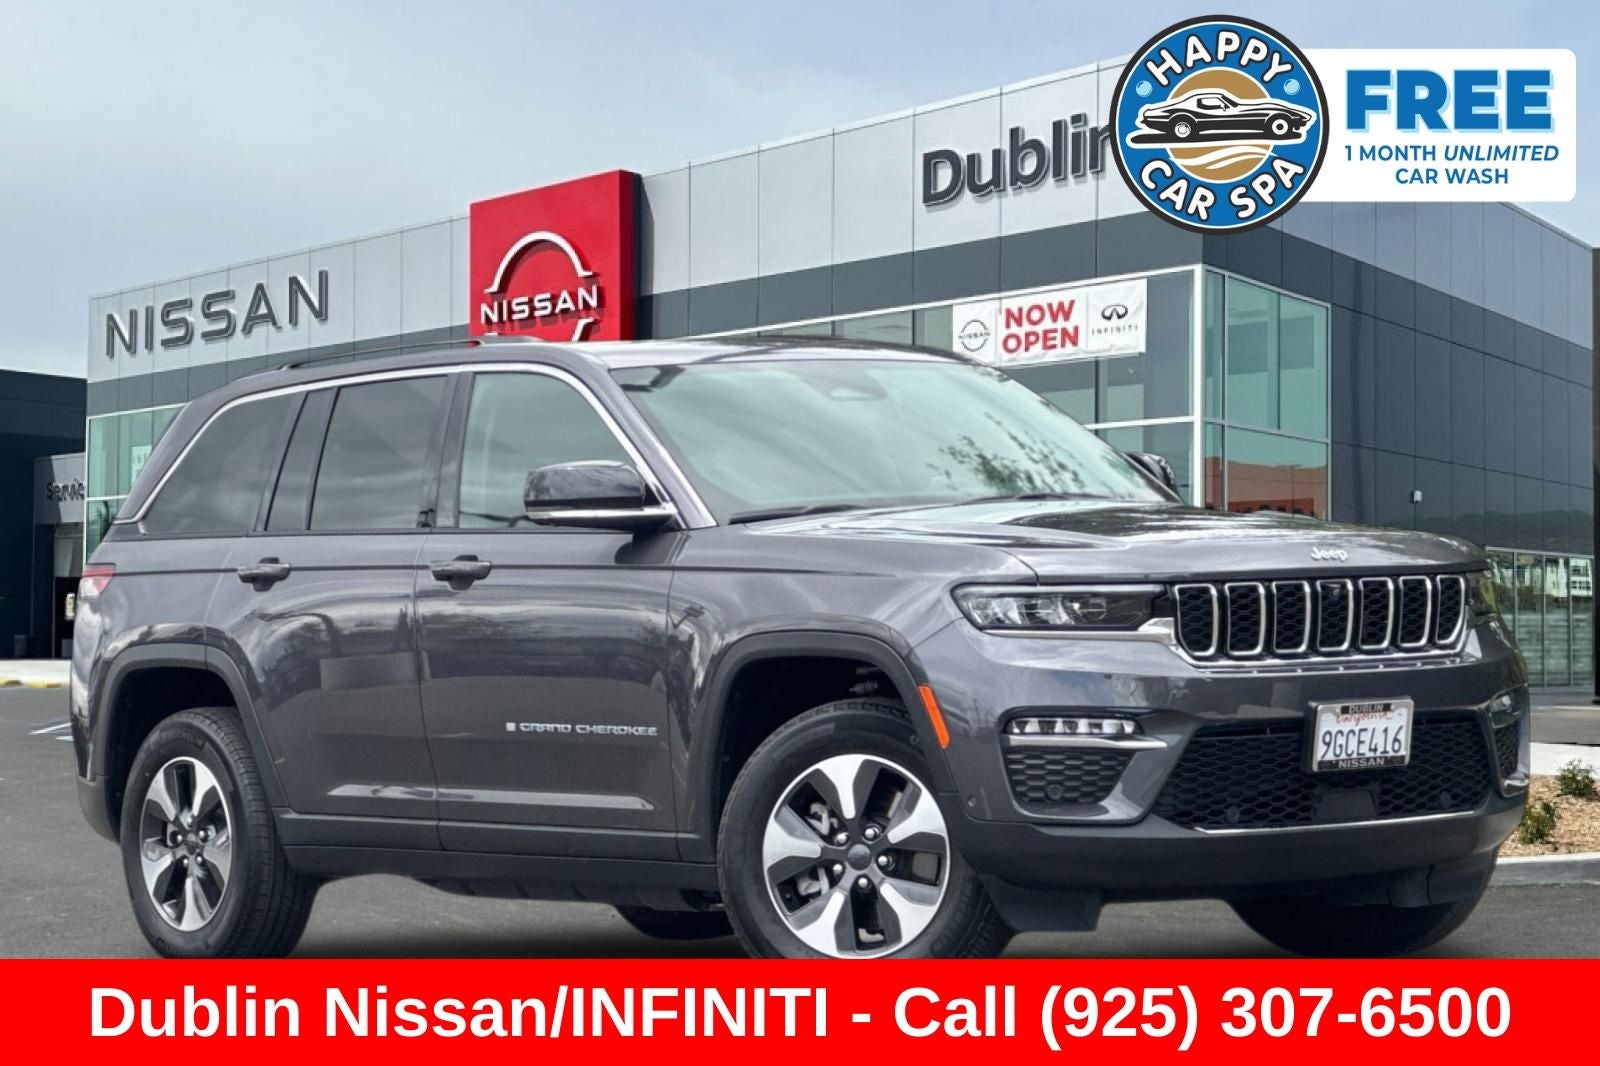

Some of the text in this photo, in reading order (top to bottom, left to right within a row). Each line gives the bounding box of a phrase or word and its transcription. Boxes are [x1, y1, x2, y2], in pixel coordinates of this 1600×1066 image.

[105, 269, 329, 358] NISSAN
[480, 285, 598, 326] NISSAN
[1004, 300, 1076, 329] NOW
[1002, 325, 1079, 353] OPEN
[1091, 324, 1139, 336] INFINITI
[1310, 547, 1348, 561] Jeep
[1349, 704, 1384, 714] DUBLIN
[519, 722, 658, 736] GRAND CHEROKEE
[1321, 725, 1404, 759] 9GCE416
[1338, 757, 1385, 769] NISSAN
